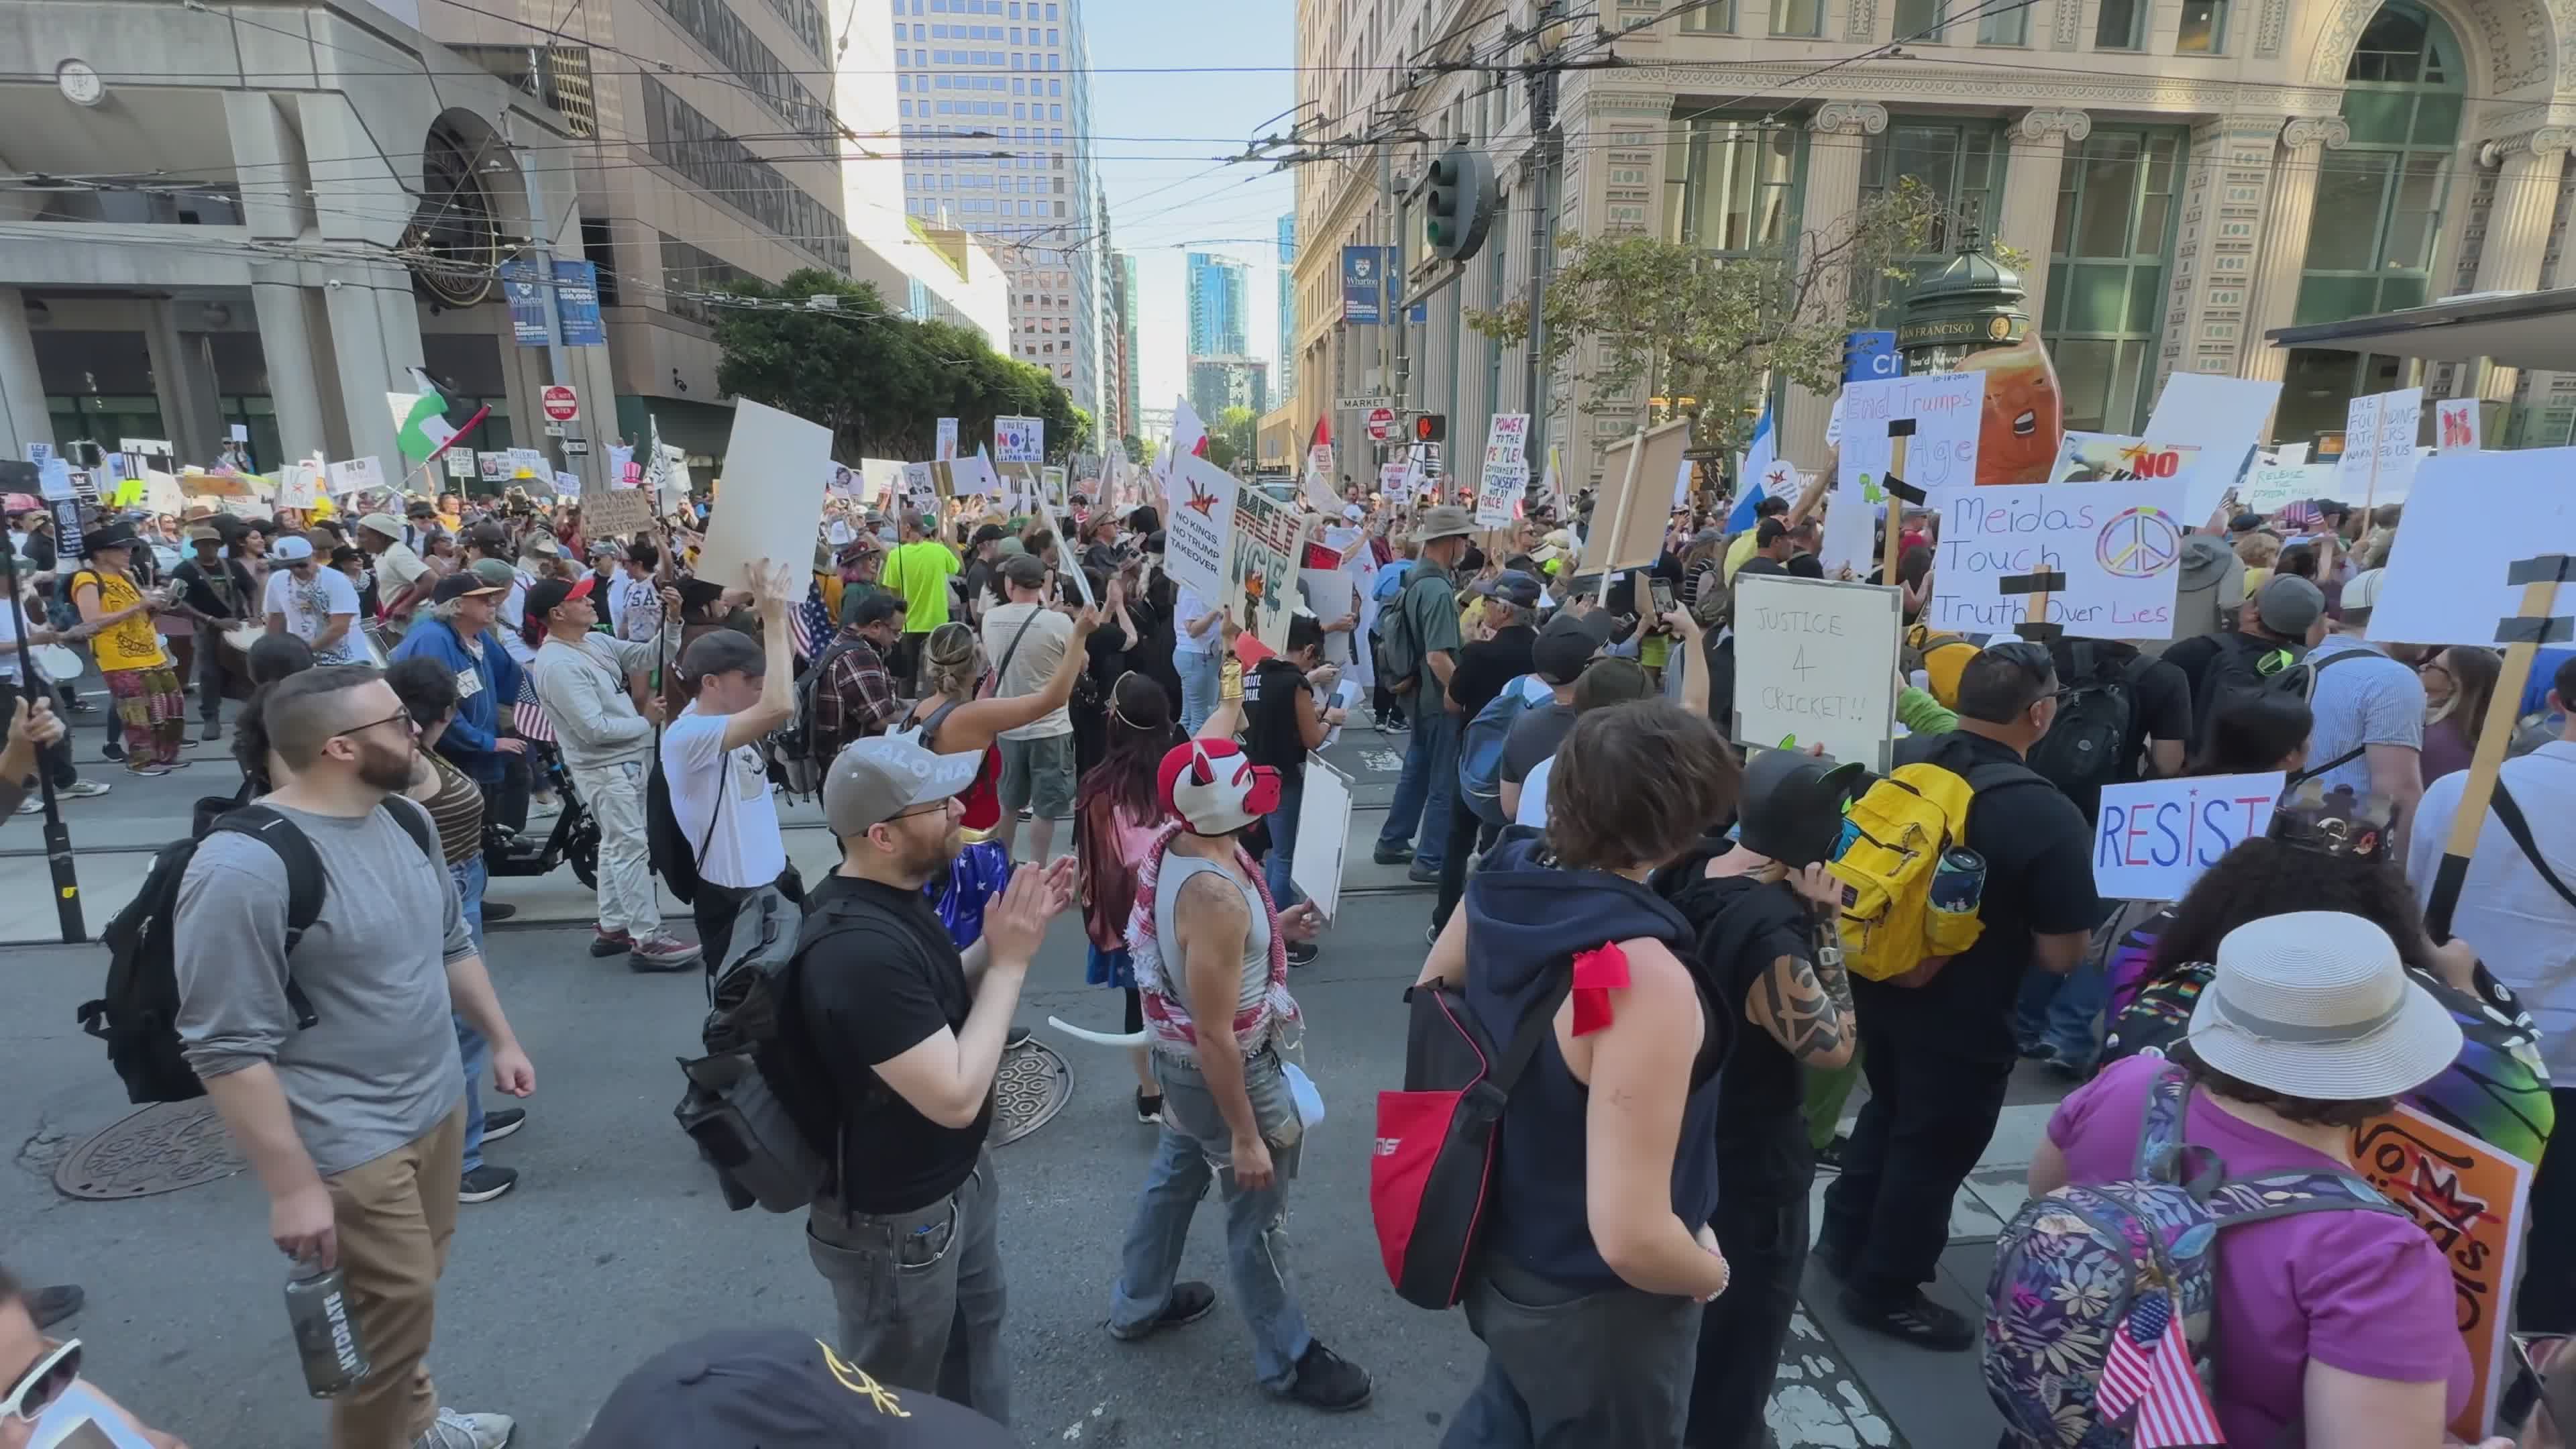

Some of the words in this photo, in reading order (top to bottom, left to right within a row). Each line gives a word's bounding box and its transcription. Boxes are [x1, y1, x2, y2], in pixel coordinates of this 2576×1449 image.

[1346, 276, 1378, 285] Wharton
[1915, 322, 1974, 336] FRANCISCO
[1910, 355, 1931, 368] You'd
[1344, 398, 1385, 407] MARKET
[1847, 386, 1891, 419] End
[2351, 398, 2373, 411] THE
[1494, 417, 1525, 434] POWER
[1496, 435, 1504, 443] TO
[1505, 435, 1519, 443] THE
[1908, 426, 1973, 486] Age
[2135, 451, 2180, 478] NO
[2395, 444, 2410, 455] US
[345, 460, 366, 472] NO
[2255, 470, 2305, 480] RELEASE
[1490, 474, 1518, 490] CONSENT
[1500, 490, 1509, 498] BY
[1481, 495, 1505, 510] FORCE!
[1955, 494, 2094, 534] Meidas
[1176, 511, 1189, 525] NO
[1190, 517, 1219, 547] KINGS.
[1234, 486, 1301, 558] MELT
[1170, 537, 1219, 576] TAKEOVER.
[1173, 525, 1187, 539] NO
[1187, 531, 1220, 559] TRUMP
[1943, 541, 2061, 572] Touch
[1231, 530, 1288, 614] ICE
[1755, 607, 1844, 637] JUSTICE
[1935, 595, 2027, 625] Truth
[2112, 601, 2169, 624] Lies
[1792, 643, 1817, 682] 4
[1762, 686, 1867, 721] CRICKET!!
[869, 745, 973, 784] ALOHA
[2100, 793, 2271, 867] RESIST
[323, 1291, 358, 1371] HYDRATE
